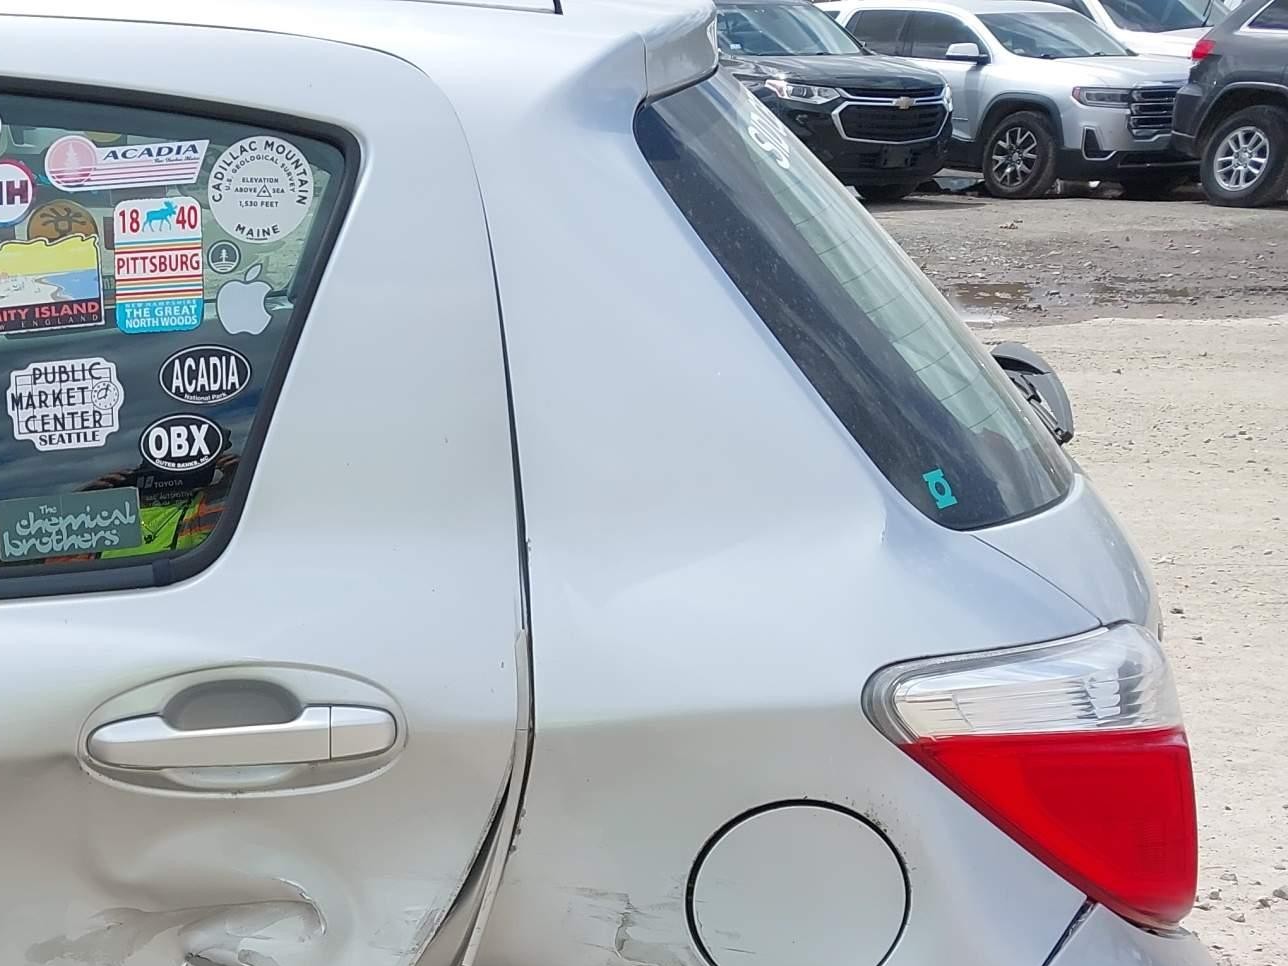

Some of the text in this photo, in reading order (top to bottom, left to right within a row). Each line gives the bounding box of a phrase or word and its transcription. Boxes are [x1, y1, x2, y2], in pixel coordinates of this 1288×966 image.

[104, 143, 199, 161] ACADIA
[211, 140, 308, 205] CADILLAC MOUNTAIN
[232, 154, 279, 174] GEOLOGICAL
[280, 162, 296, 193] SURVEY
[239, 200, 258, 208] 1,530
[118, 205, 198, 234] 18 40
[235, 223, 280, 237] MAINE
[117, 253, 200, 275] PITTSBURG
[35, 301, 99, 318] ISLAND
[125, 305, 197, 318] THE GREAT
[21, 315, 98, 328] ENGLAND
[125, 315, 198, 329] NORTH WOODS
[33, 362, 102, 386] PUBLIC
[172, 355, 240, 393] ACADIA
[11, 386, 89, 411] MARKET
[184, 392, 227, 401] National Park
[25, 411, 103, 433] CENTER
[38, 431, 101, 446] SEATTLE
[148, 424, 211, 459] OBX
[155, 458, 176, 468] OUTER
[39, 505, 57, 514] The
[3, 530, 120, 557] brothers
